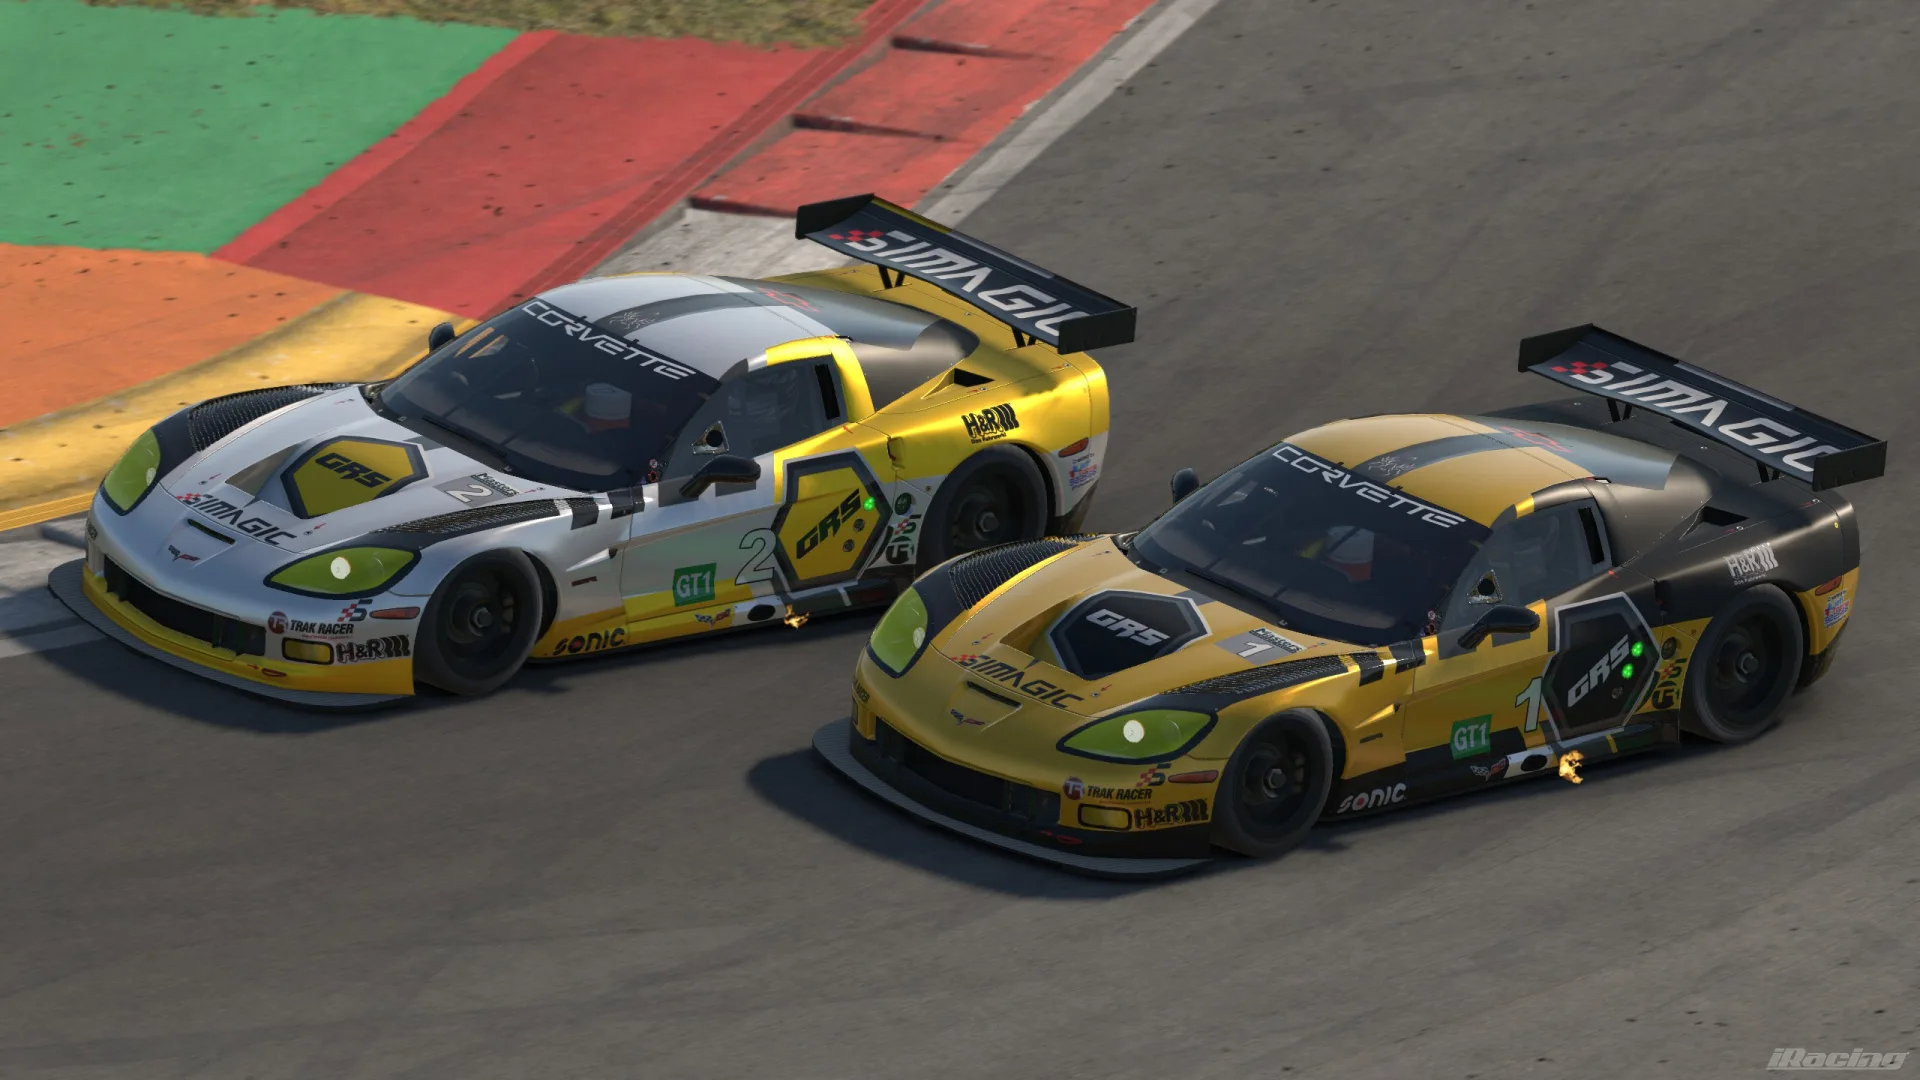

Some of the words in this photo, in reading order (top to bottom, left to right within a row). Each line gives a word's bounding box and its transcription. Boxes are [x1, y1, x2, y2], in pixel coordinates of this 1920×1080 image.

[522, 300, 696, 380] CORVETTE
[315, 453, 392, 488] GRS
[1272, 446, 1466, 528] CORVETTE
[444, 484, 493, 503] 2
[176, 493, 297, 546] SIMAGIC
[797, 488, 860, 559] GRS
[735, 528, 777, 586] 2
[676, 567, 712, 599] GT1
[290, 620, 316, 634] TRAK
[318, 622, 354, 635] RACER
[1085, 609, 1171, 646] GRS
[1236, 641, 1274, 658] 1
[951, 654, 1084, 710] SIMAGIC
[1567, 634, 1630, 708] GRS
[1515, 677, 1543, 733] 1
[1454, 722, 1489, 751] GT1
[1087, 785, 1113, 799] TRAK
[1116, 788, 1153, 800] RACER
